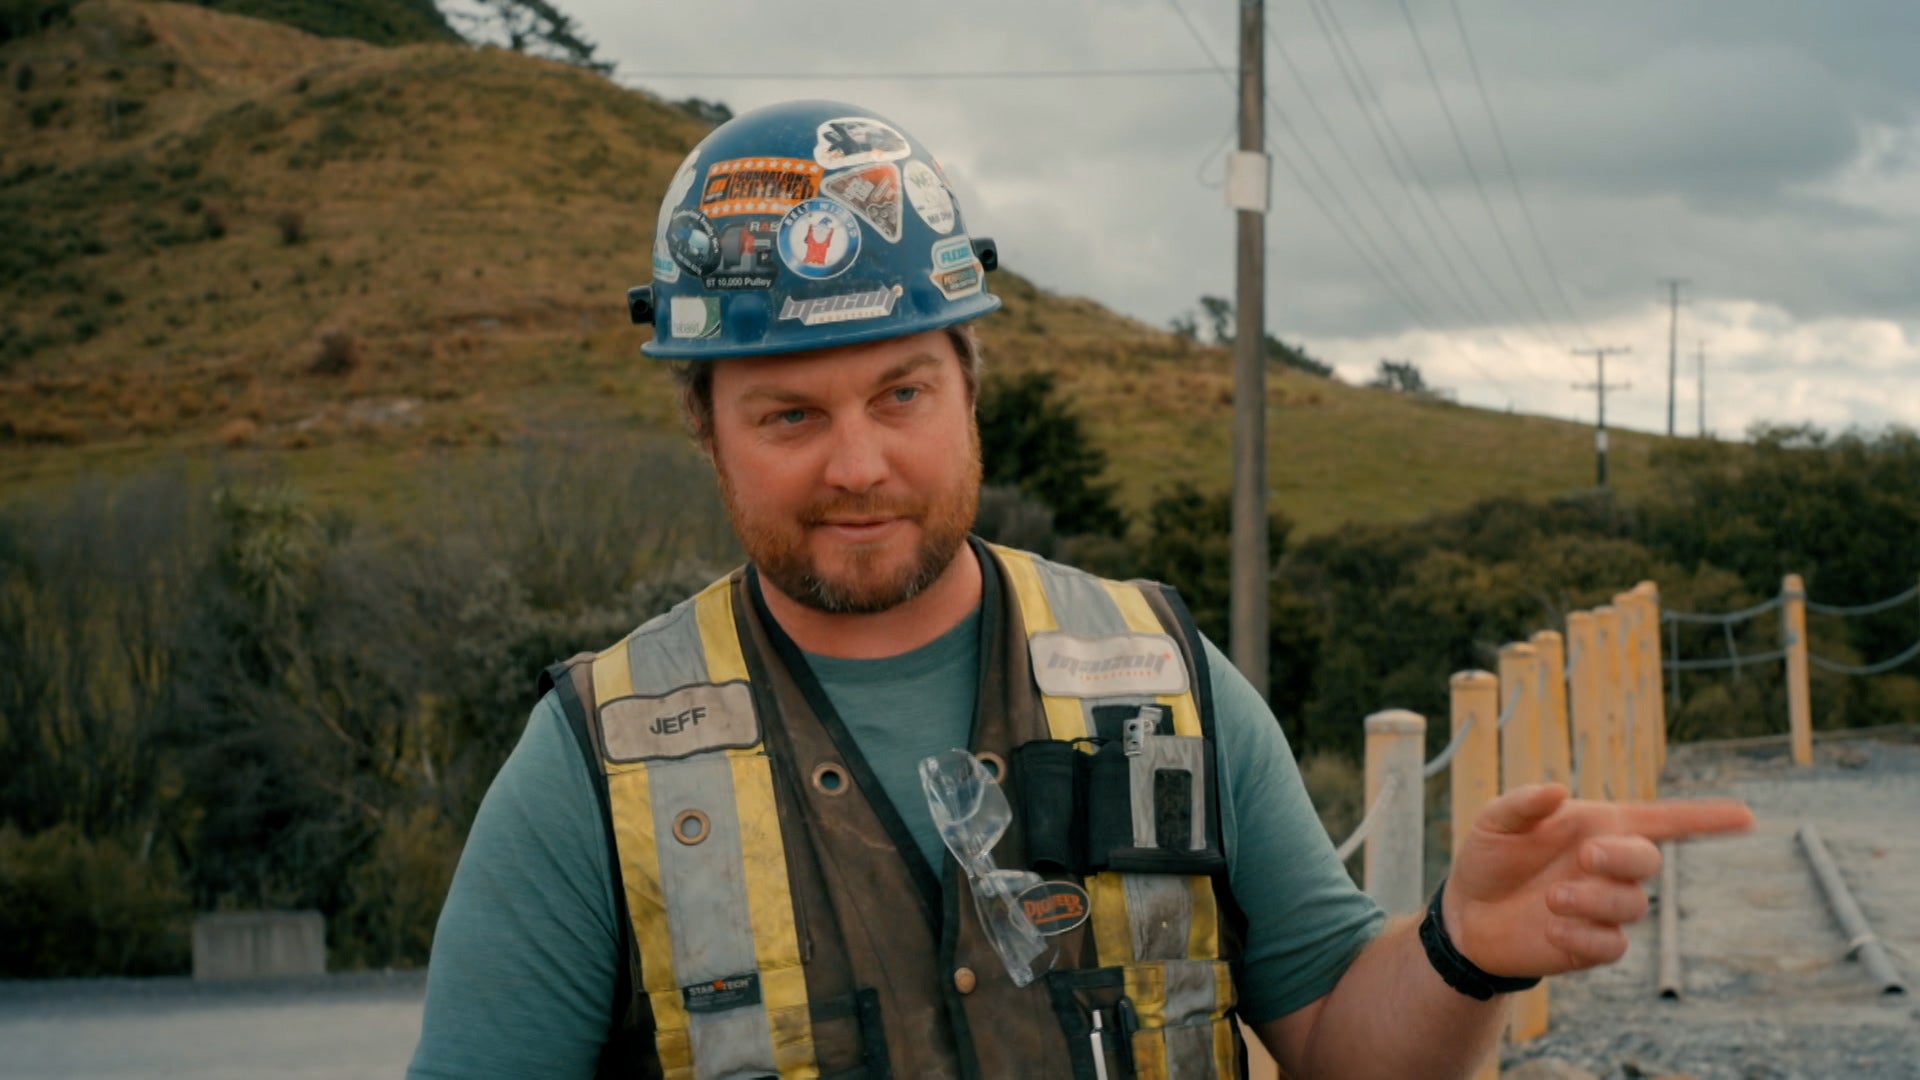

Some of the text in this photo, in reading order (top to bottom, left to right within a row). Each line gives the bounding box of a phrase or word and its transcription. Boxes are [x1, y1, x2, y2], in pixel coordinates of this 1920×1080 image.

[729, 181, 815, 200] CERTIFIED
[717, 277, 743, 287] 10,000
[744, 277, 772, 288] Pulley
[649, 706, 707, 735] JEFF
[1023, 893, 1084, 919] PIONEER
